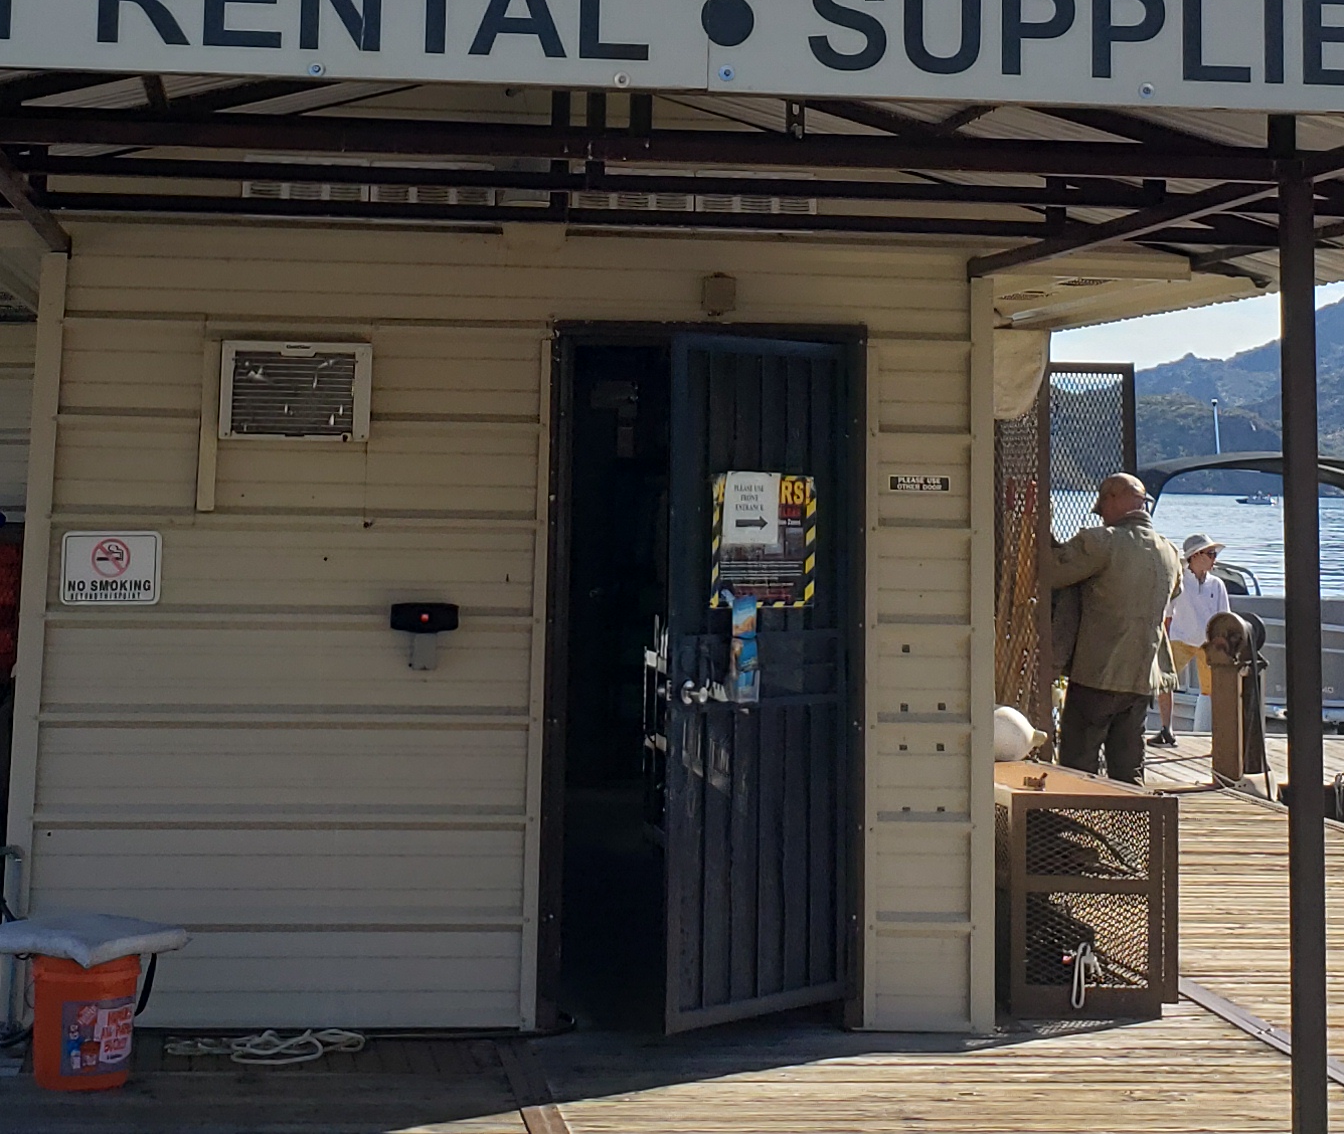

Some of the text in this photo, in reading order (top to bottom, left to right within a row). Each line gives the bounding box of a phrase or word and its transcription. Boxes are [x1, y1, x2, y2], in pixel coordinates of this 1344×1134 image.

[898, 476, 924, 484] PLEASE
[897, 483, 942, 491] OTHER DOOR
[67, 579, 151, 592] NO SMOKING
